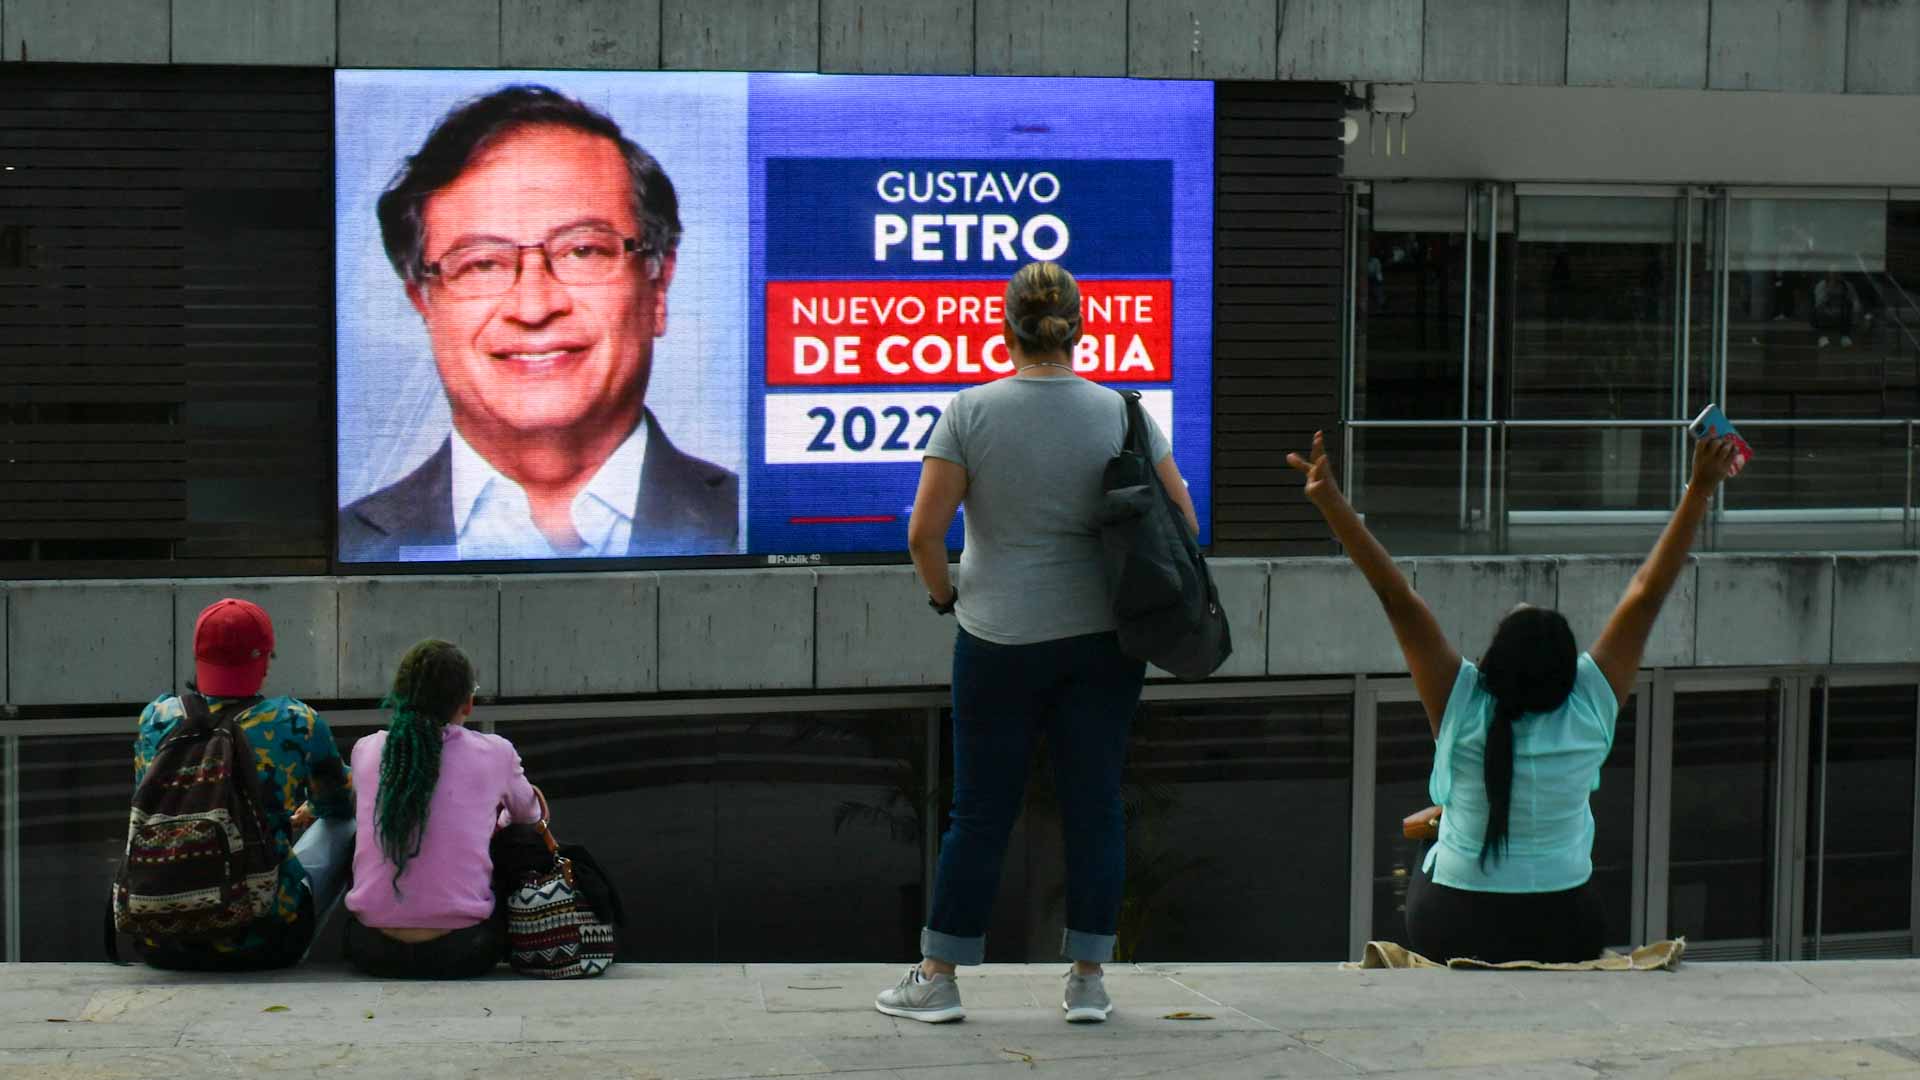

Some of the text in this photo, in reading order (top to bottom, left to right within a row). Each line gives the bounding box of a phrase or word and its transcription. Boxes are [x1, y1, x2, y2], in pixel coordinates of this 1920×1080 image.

[876, 171, 1061, 203] GUSTAVO
[874, 214, 1070, 262] PETRO
[792, 295, 1153, 326] NUEVO PRENTE
[794, 334, 1155, 374] DE COLOBIA
